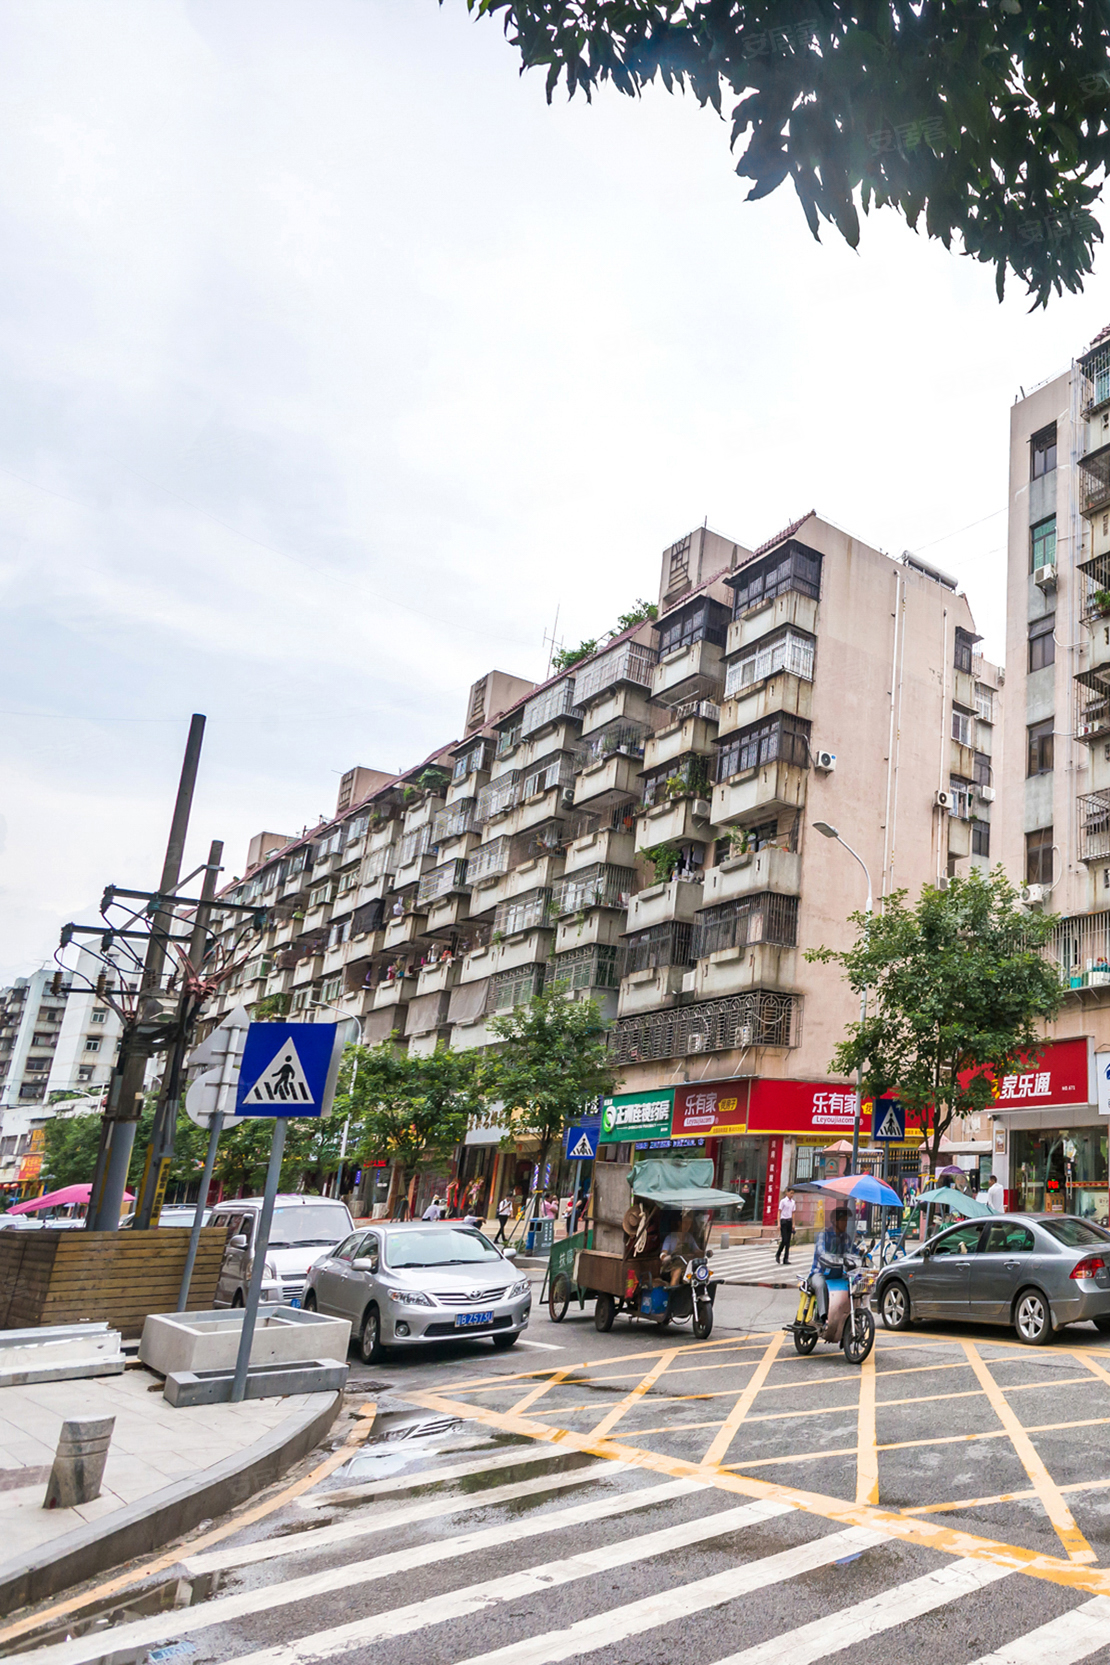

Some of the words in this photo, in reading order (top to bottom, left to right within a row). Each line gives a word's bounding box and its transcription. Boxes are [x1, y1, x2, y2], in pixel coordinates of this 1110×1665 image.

[684, 1092, 718, 1116] 乐有家
[812, 1092, 857, 1114] 乐有家
